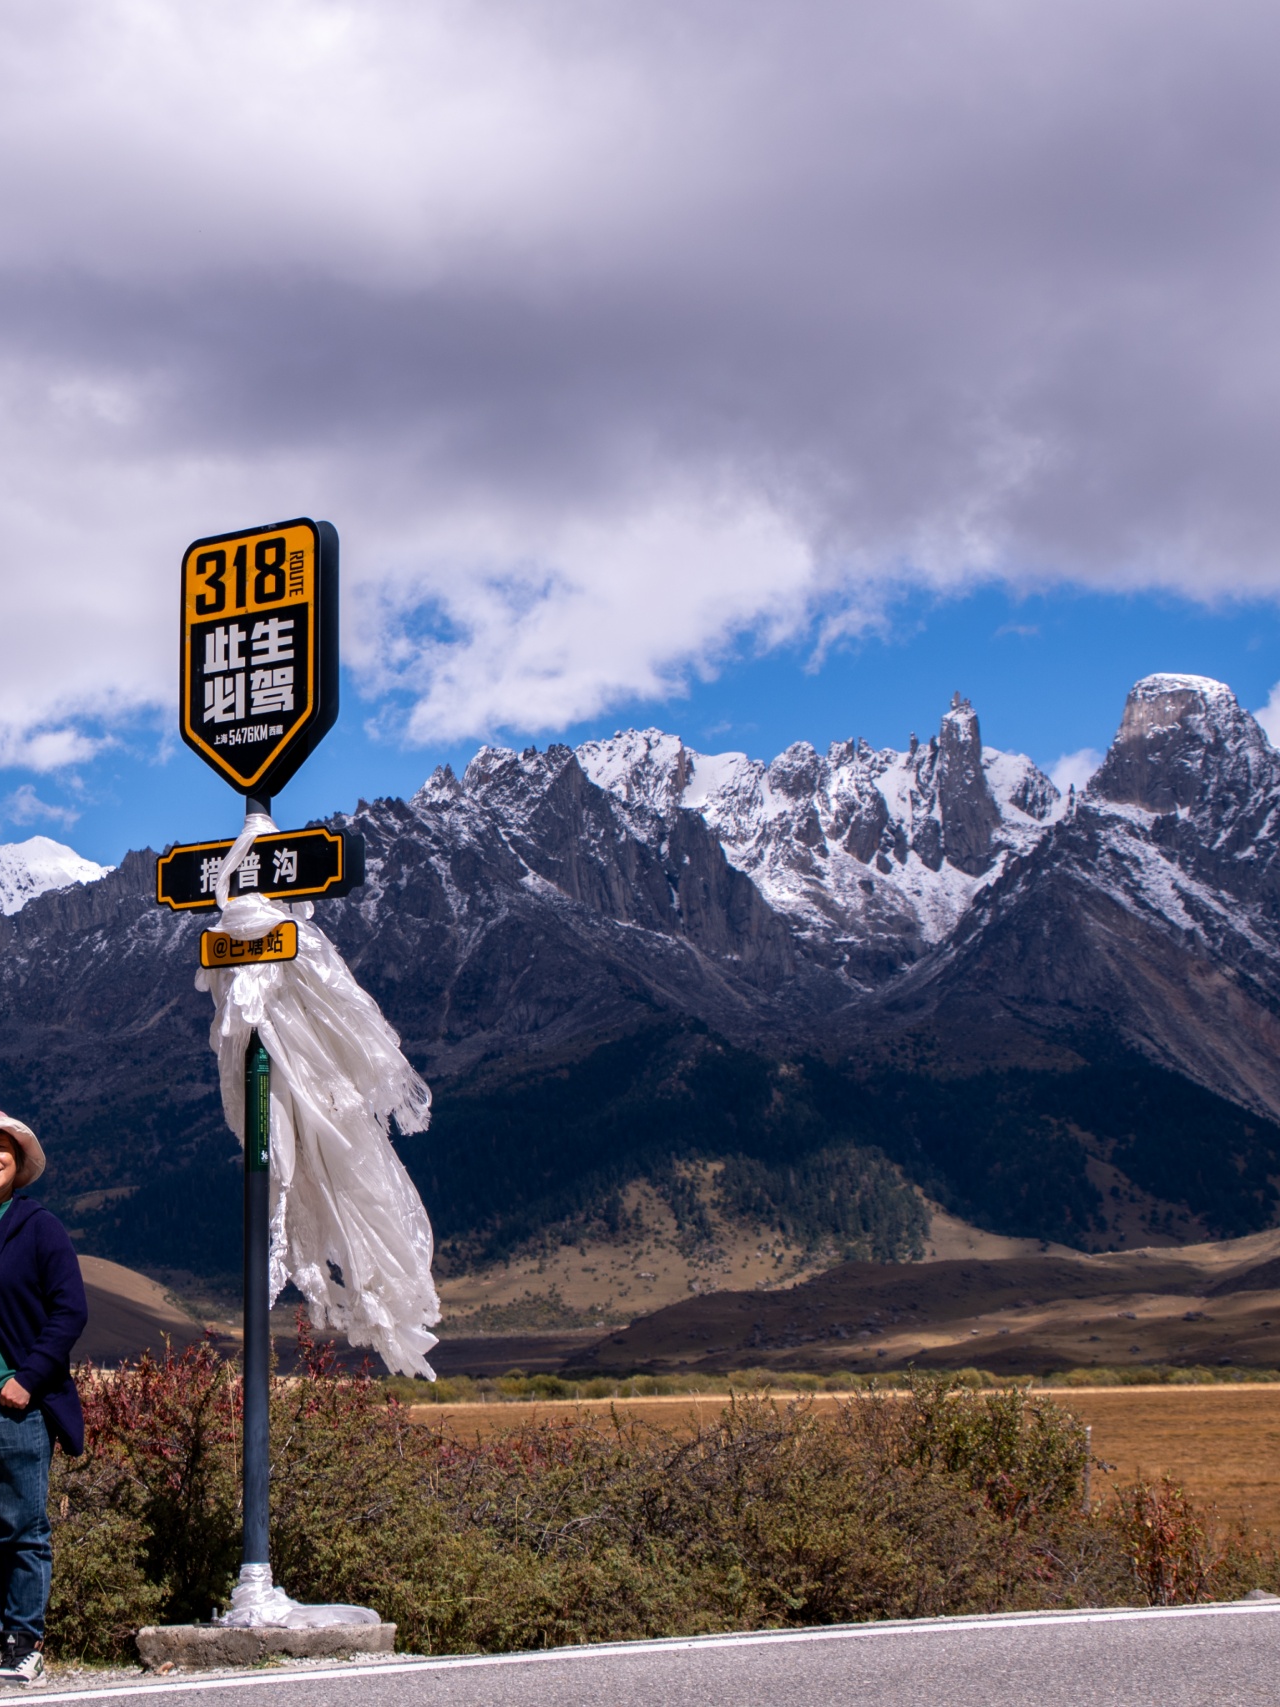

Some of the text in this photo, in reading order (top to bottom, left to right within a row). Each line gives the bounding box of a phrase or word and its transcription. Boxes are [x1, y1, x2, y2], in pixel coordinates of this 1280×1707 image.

[196, 537, 286, 616] 318
[289, 550, 304, 598] ROUTE
[203, 617, 295, 674] 此生
[203, 665, 295, 724] 必驾
[214, 733, 228, 745] 上海
[229, 724, 268, 746] 5476KM
[200, 847, 298, 893] 措普沟
